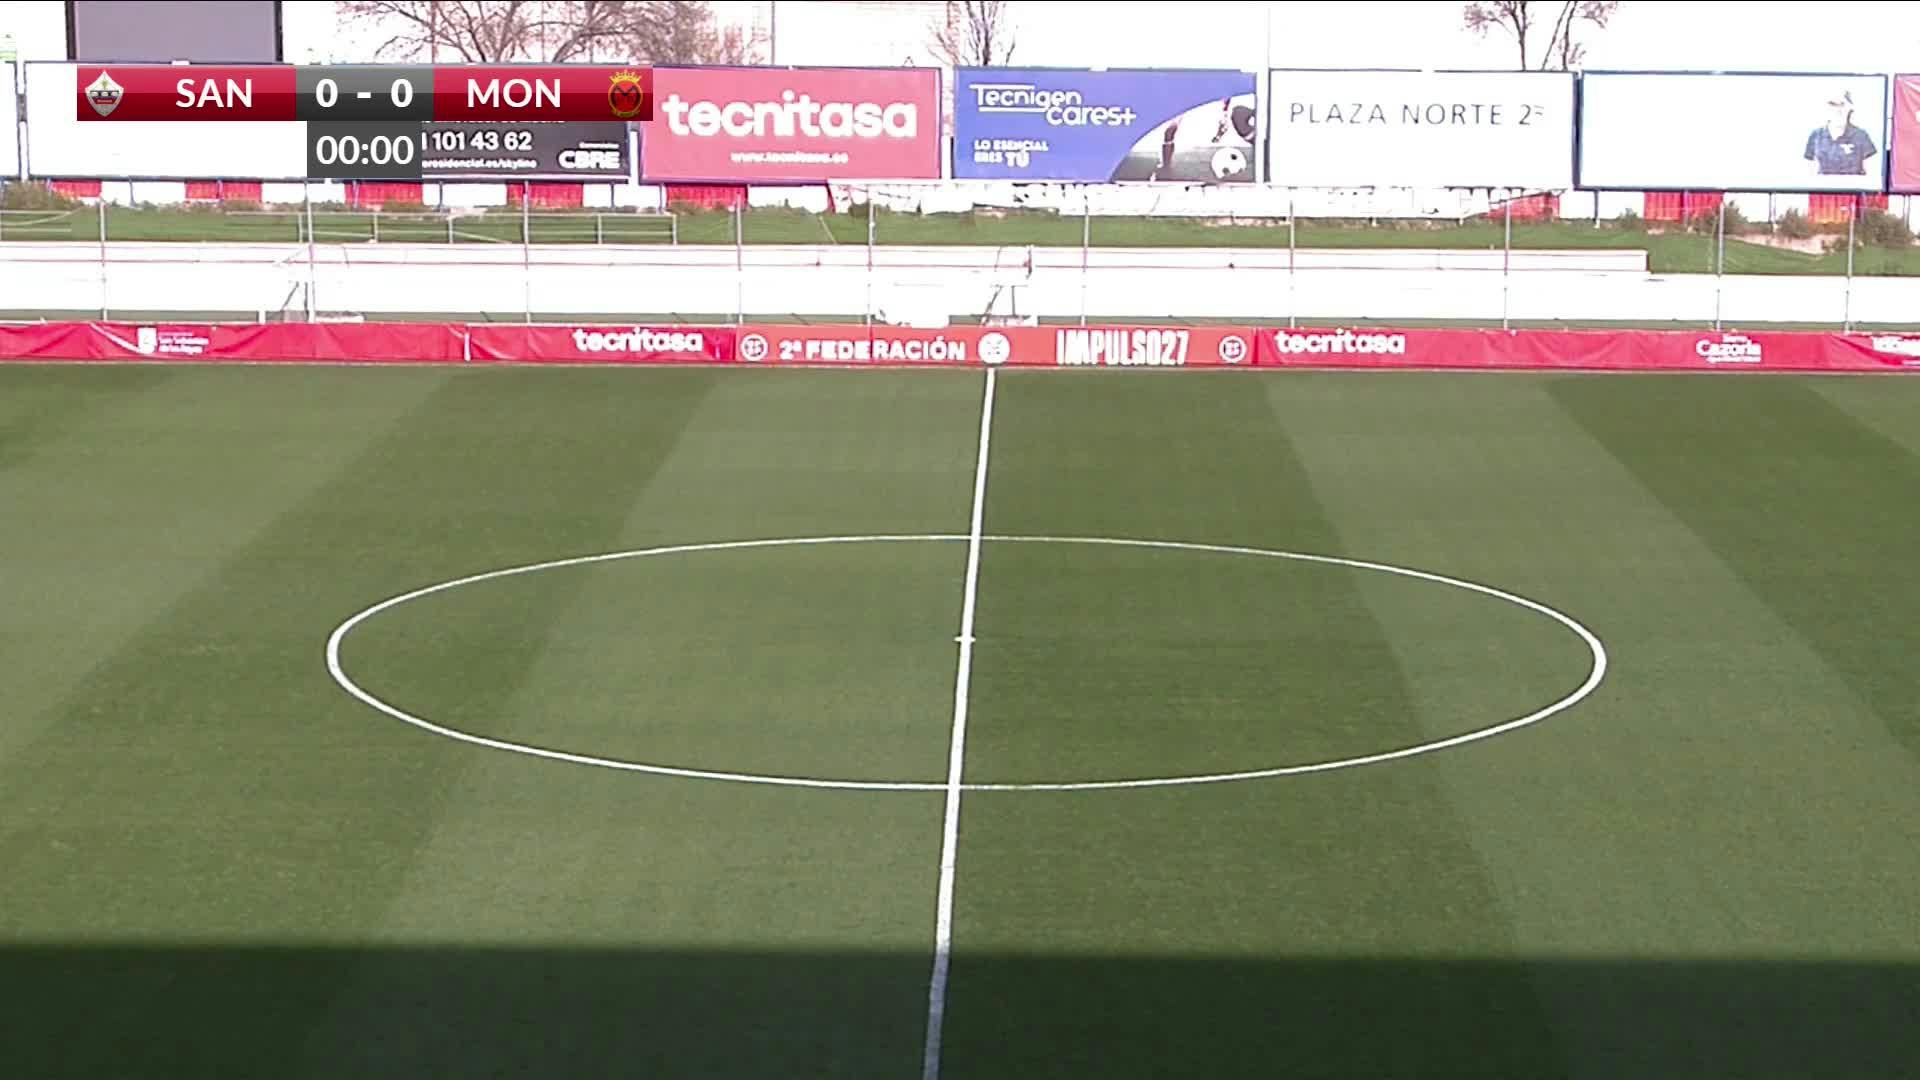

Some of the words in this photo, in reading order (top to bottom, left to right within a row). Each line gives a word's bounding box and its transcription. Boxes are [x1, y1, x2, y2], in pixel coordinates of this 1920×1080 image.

[969, 84, 1082, 113] Tecnigen
[661, 90, 918, 137] tecnitasa
[1290, 102, 1387, 125] PLAZA
[1402, 103, 1503, 126] NORTE
[433, 131, 465, 150] 101
[470, 132, 499, 151] 43
[504, 131, 533, 151] 62
[974, 139, 991, 151] LO
[558, 150, 621, 169] CBRE
[1005, 149, 1030, 168] TÚ
[573, 326, 703, 352] tecnitasa
[806, 336, 966, 361] FEDERACIÓN
[1056, 329, 1189, 365] IMPULSO27
[1274, 327, 1406, 354] tecnitasa
